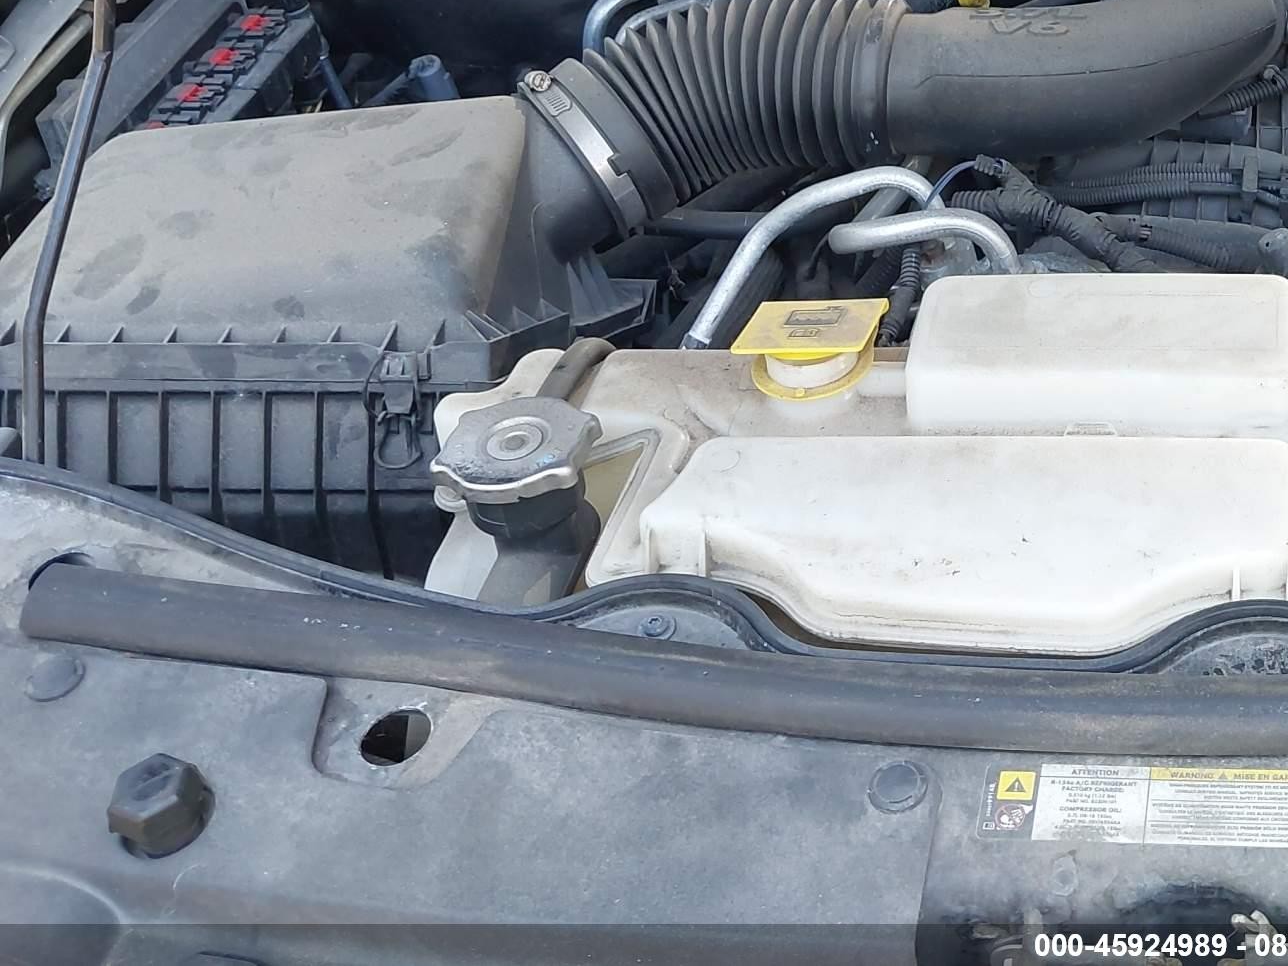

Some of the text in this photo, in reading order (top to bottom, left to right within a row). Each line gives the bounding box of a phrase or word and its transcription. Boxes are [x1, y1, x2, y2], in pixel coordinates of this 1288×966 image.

[988, 18, 1070, 35] V6
[1071, 768, 1120, 777] ATTENTION
[1170, 771, 1215, 780] WARNING
